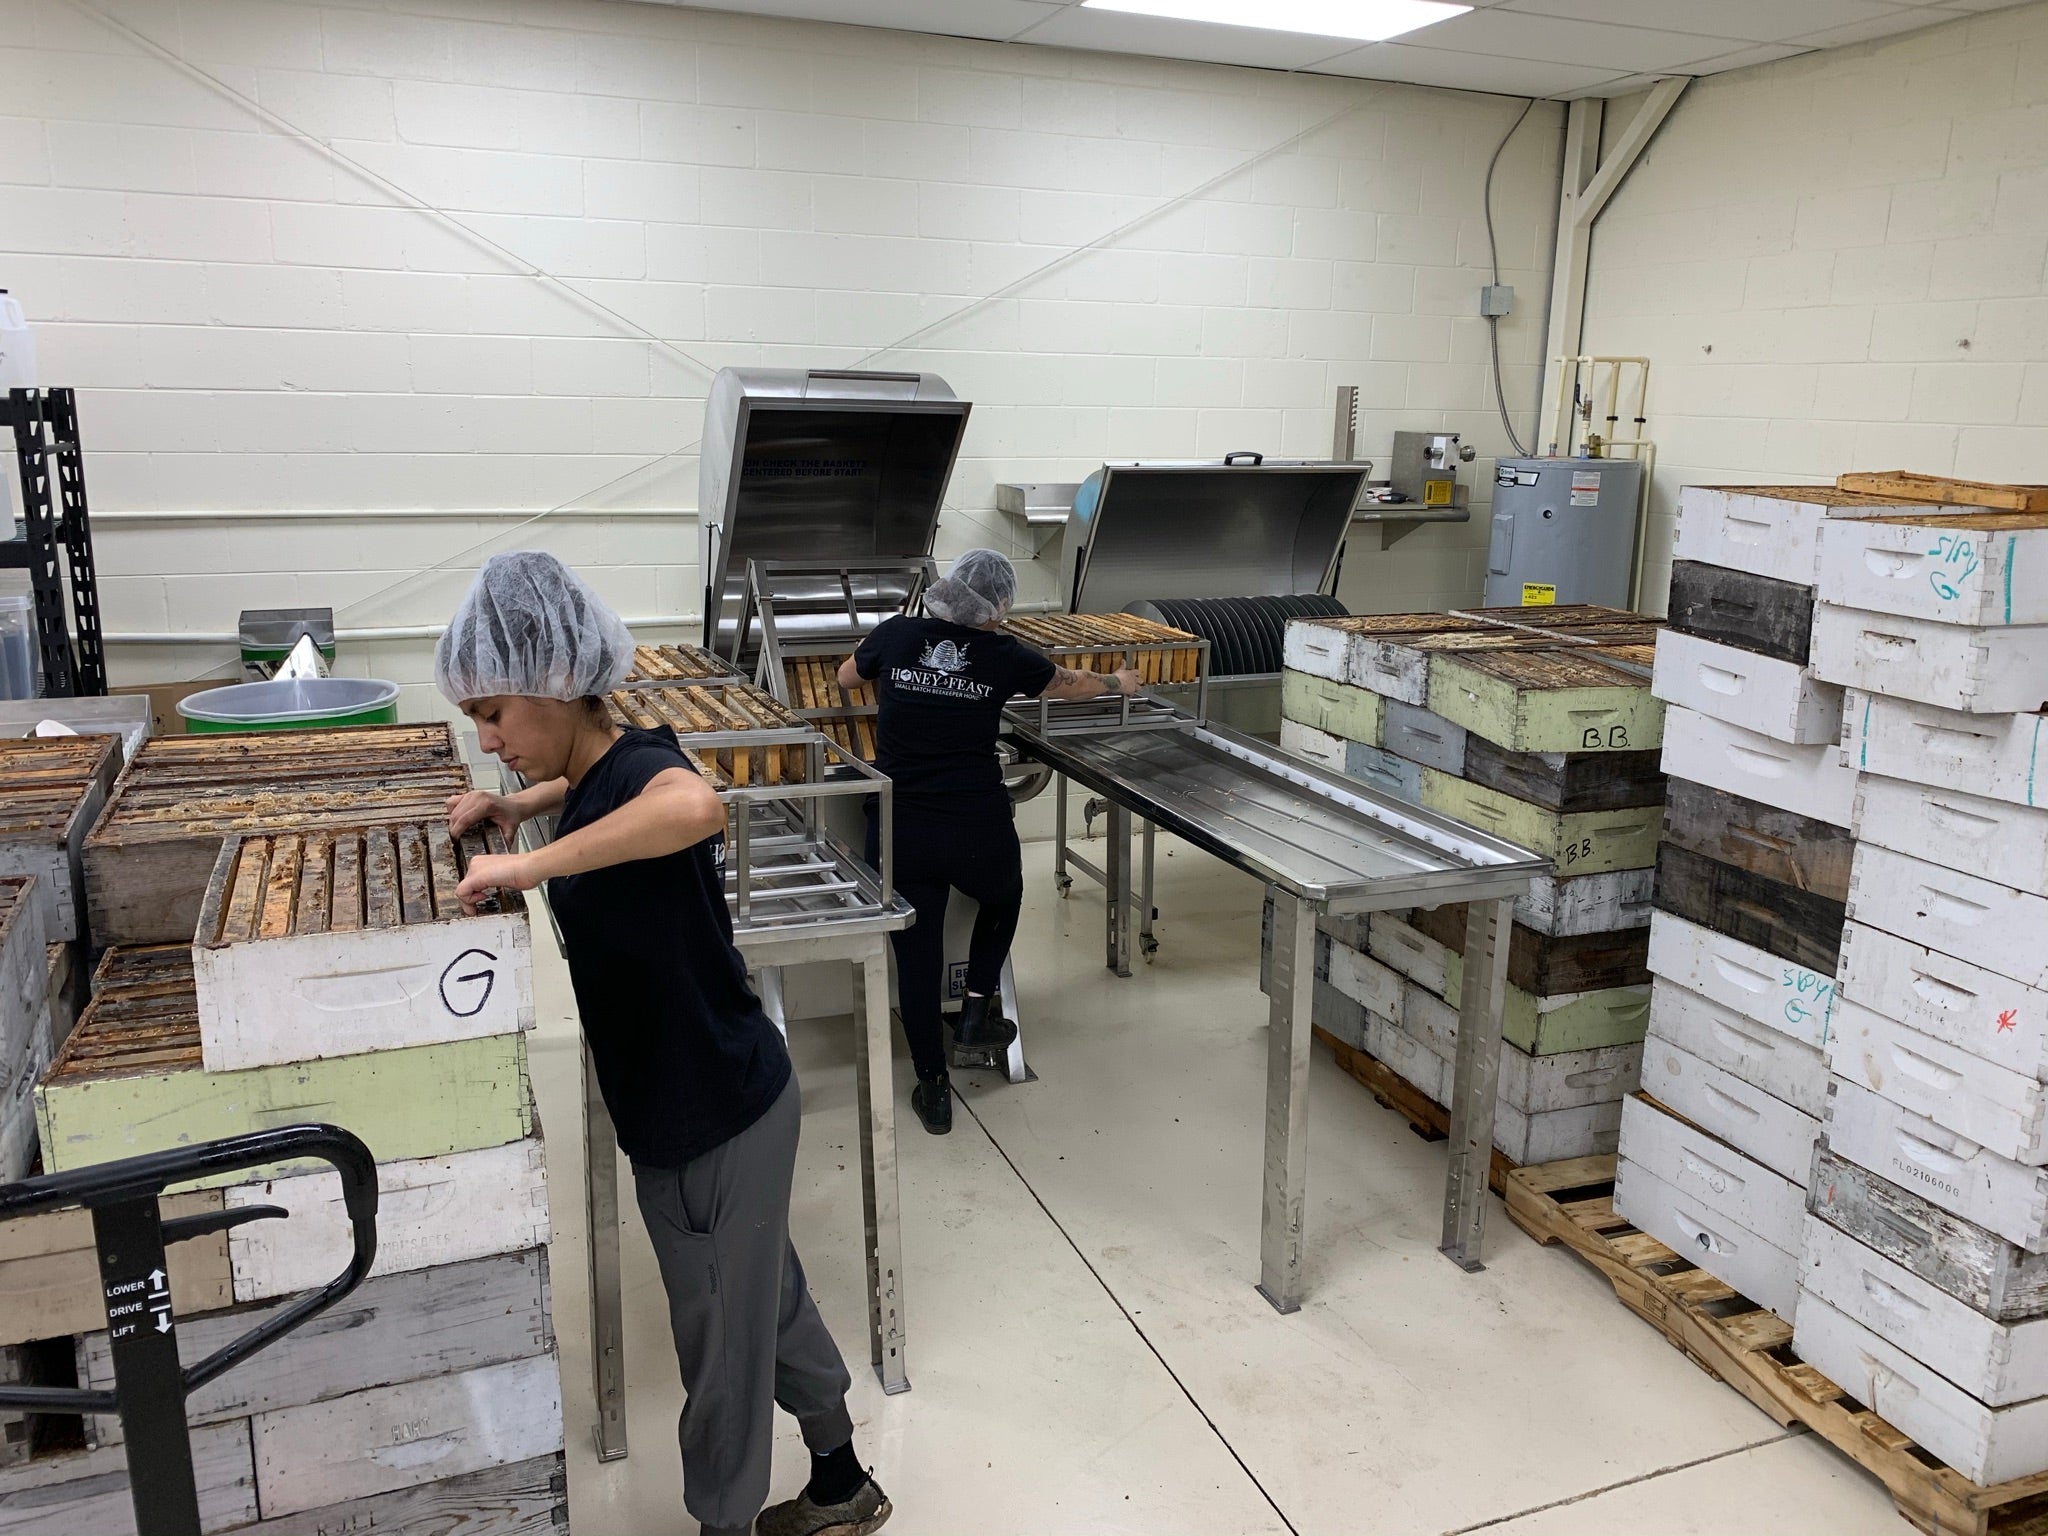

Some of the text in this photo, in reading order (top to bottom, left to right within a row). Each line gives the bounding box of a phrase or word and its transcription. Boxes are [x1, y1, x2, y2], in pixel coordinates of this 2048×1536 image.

[763, 459, 797, 467] CHECK
[801, 459, 820, 467] THE
[823, 459, 867, 468] BASKETS
[795, 468, 832, 476] BEFORE
[834, 468, 864, 476] START
[891, 667, 942, 687] HONEY
[948, 677, 993, 698] FEAST
[894, 682, 911, 691] SMALL
[912, 686, 931, 694] BATCH
[932, 689, 963, 698] BEEKEEPER
[439, 948, 498, 1017] G
[106, 1281, 146, 1297] LOWER
[109, 1302, 143, 1318] DRIVE
[112, 1325, 135, 1338] LIFT
